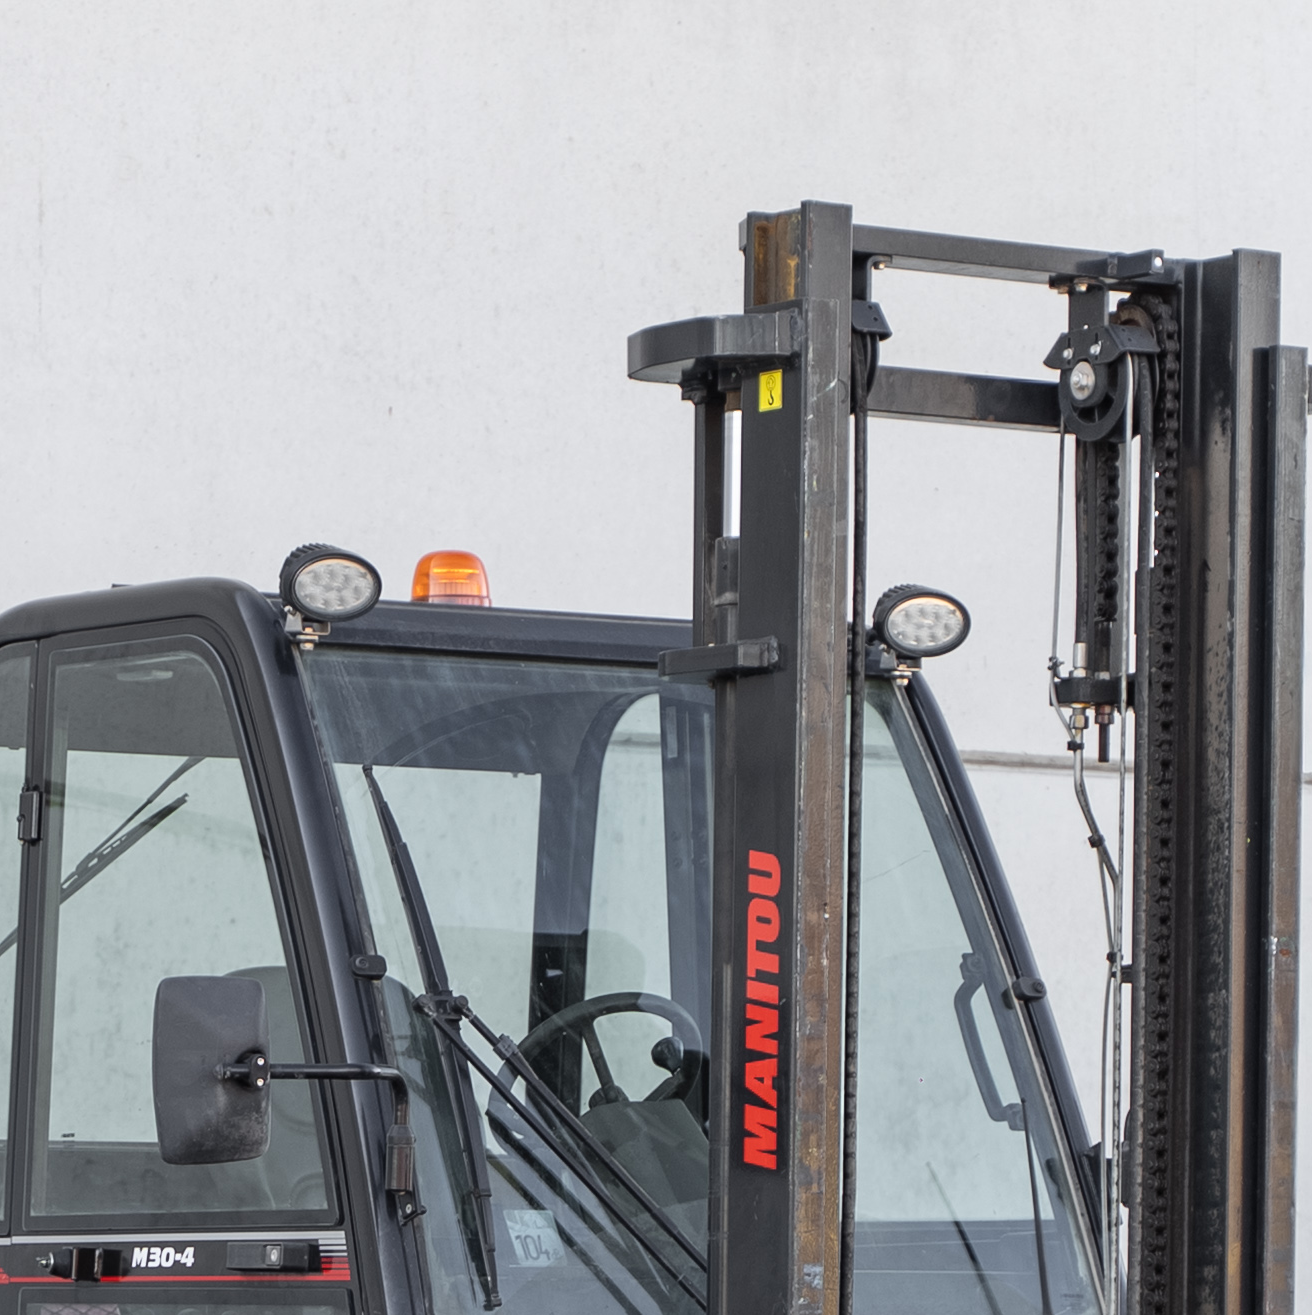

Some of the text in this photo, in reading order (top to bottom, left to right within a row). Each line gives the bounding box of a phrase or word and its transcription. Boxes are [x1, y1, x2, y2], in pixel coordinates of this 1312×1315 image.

[743, 849, 782, 1170] MANITOU
[131, 1246, 195, 1268] M30-4
[515, 1234, 551, 1261] 104
